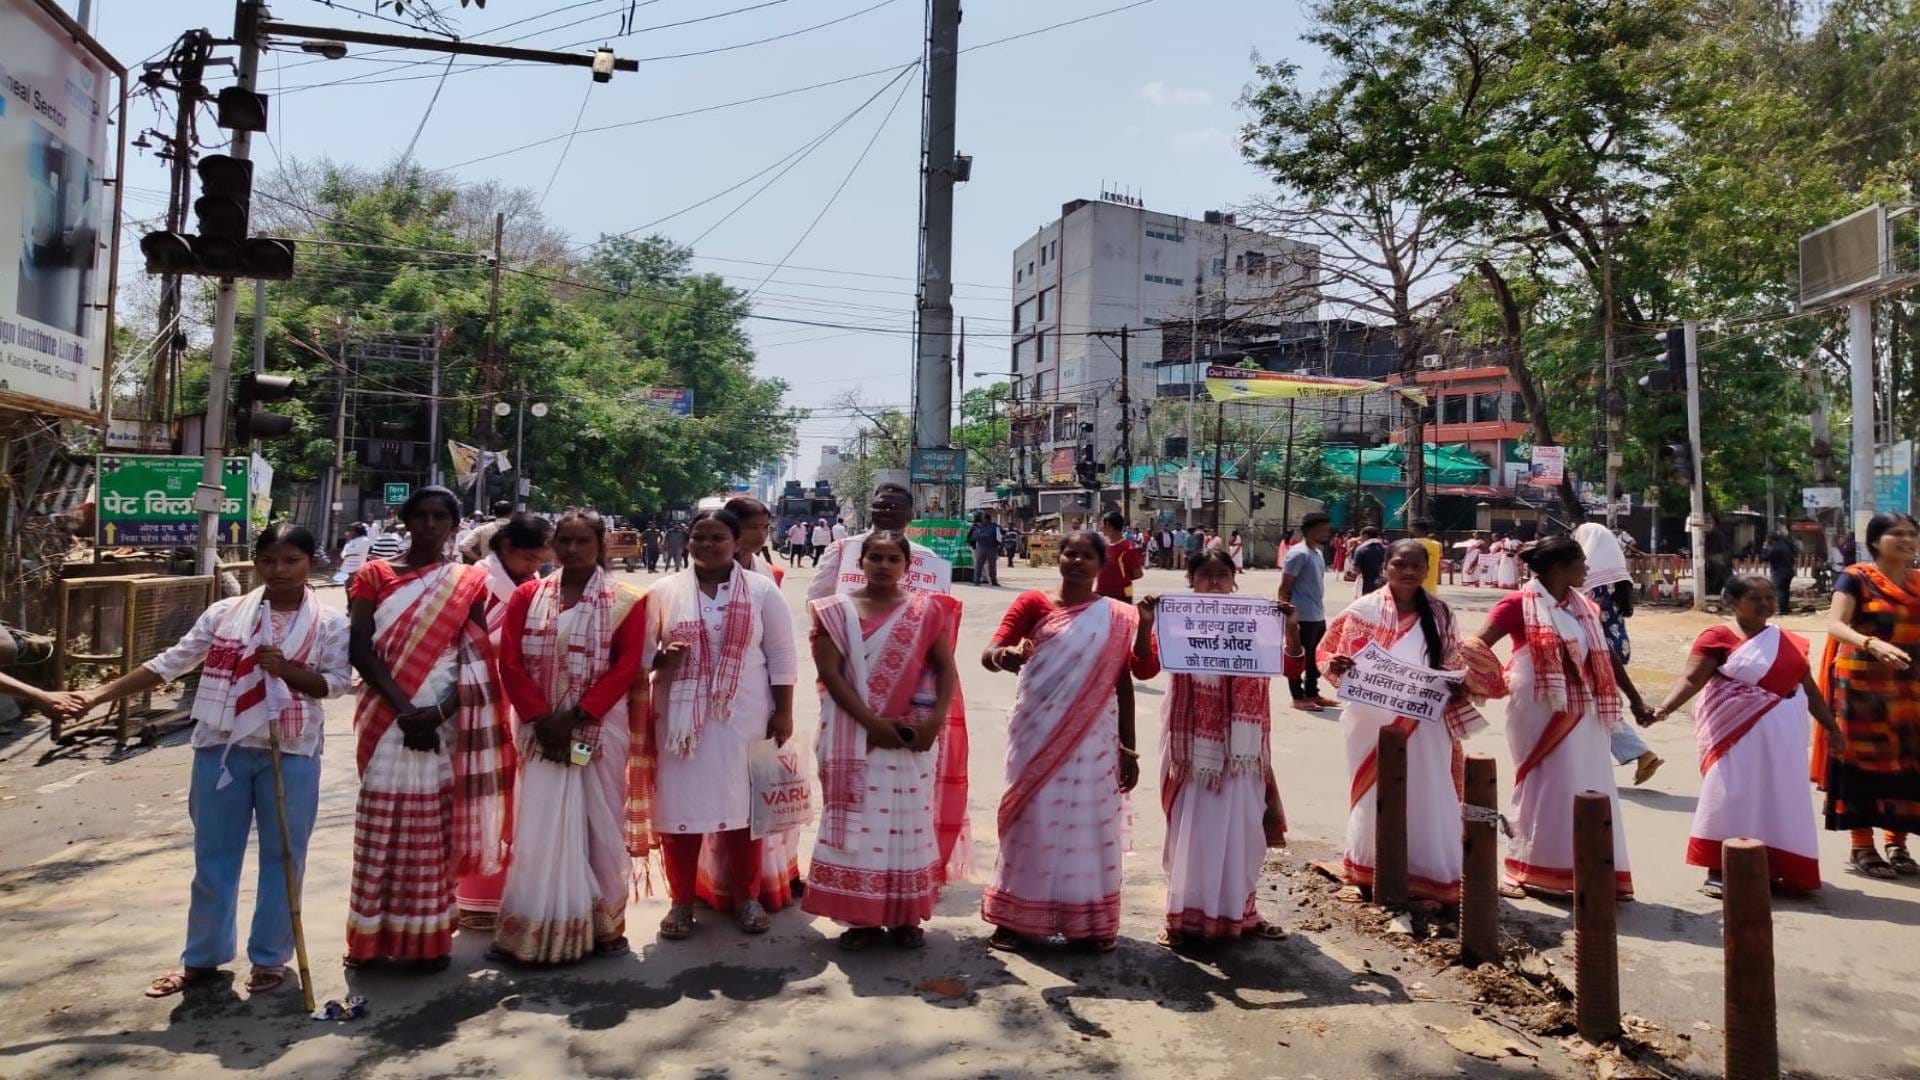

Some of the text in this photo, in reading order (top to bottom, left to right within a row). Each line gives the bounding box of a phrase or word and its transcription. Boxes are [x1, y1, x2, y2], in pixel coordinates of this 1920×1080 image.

[33, 91, 66, 128] Sector
[18, 322, 57, 356] Institute
[102, 490, 140, 514] पेट
[922, 571, 938, 584] को
[1160, 599, 1281, 617] सिरम टोली सरना स्थल
[1184, 616, 1257, 634] के मुख्य द्वार से
[1187, 635, 1252, 651] फ्लाई ओवर
[1185, 653, 1258, 670] को हटाना होगा।
[1363, 672, 1405, 692] अस्तित्व
[1407, 682, 1420, 695] के
[1347, 684, 1388, 705] खेलना
[1389, 694, 1406, 709] बंद
